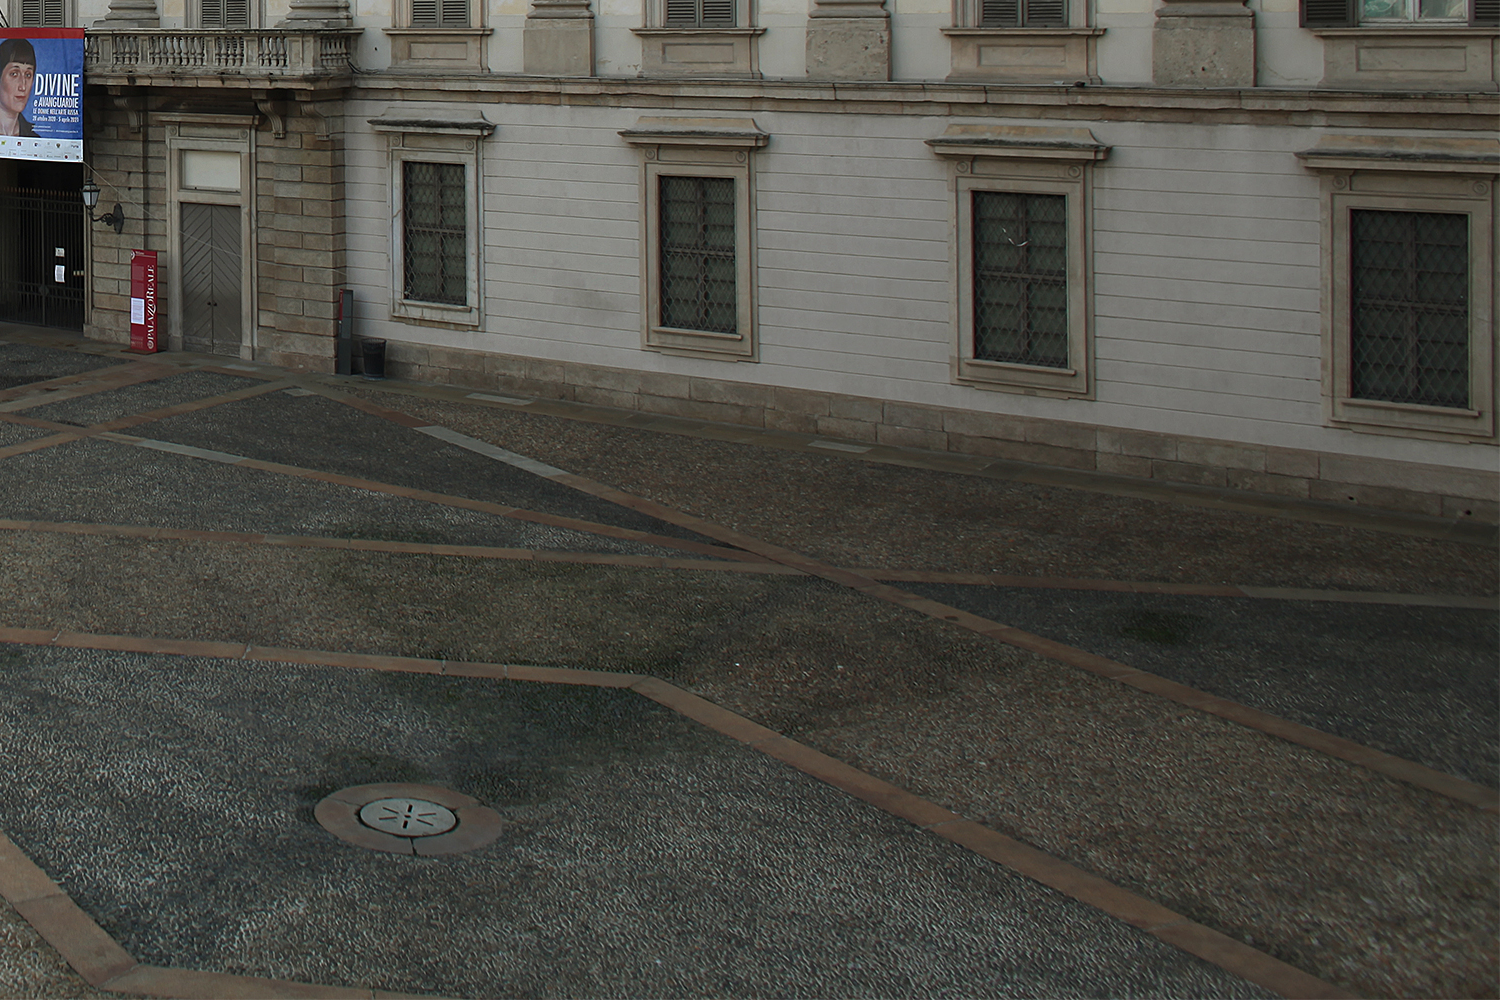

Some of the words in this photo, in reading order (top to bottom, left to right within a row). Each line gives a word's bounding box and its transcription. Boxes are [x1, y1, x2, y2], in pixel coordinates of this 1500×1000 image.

[35, 73, 80, 97] DIVINE
[33, 99, 38, 107] e
[38, 97, 79, 108] AVANGUARDIE
